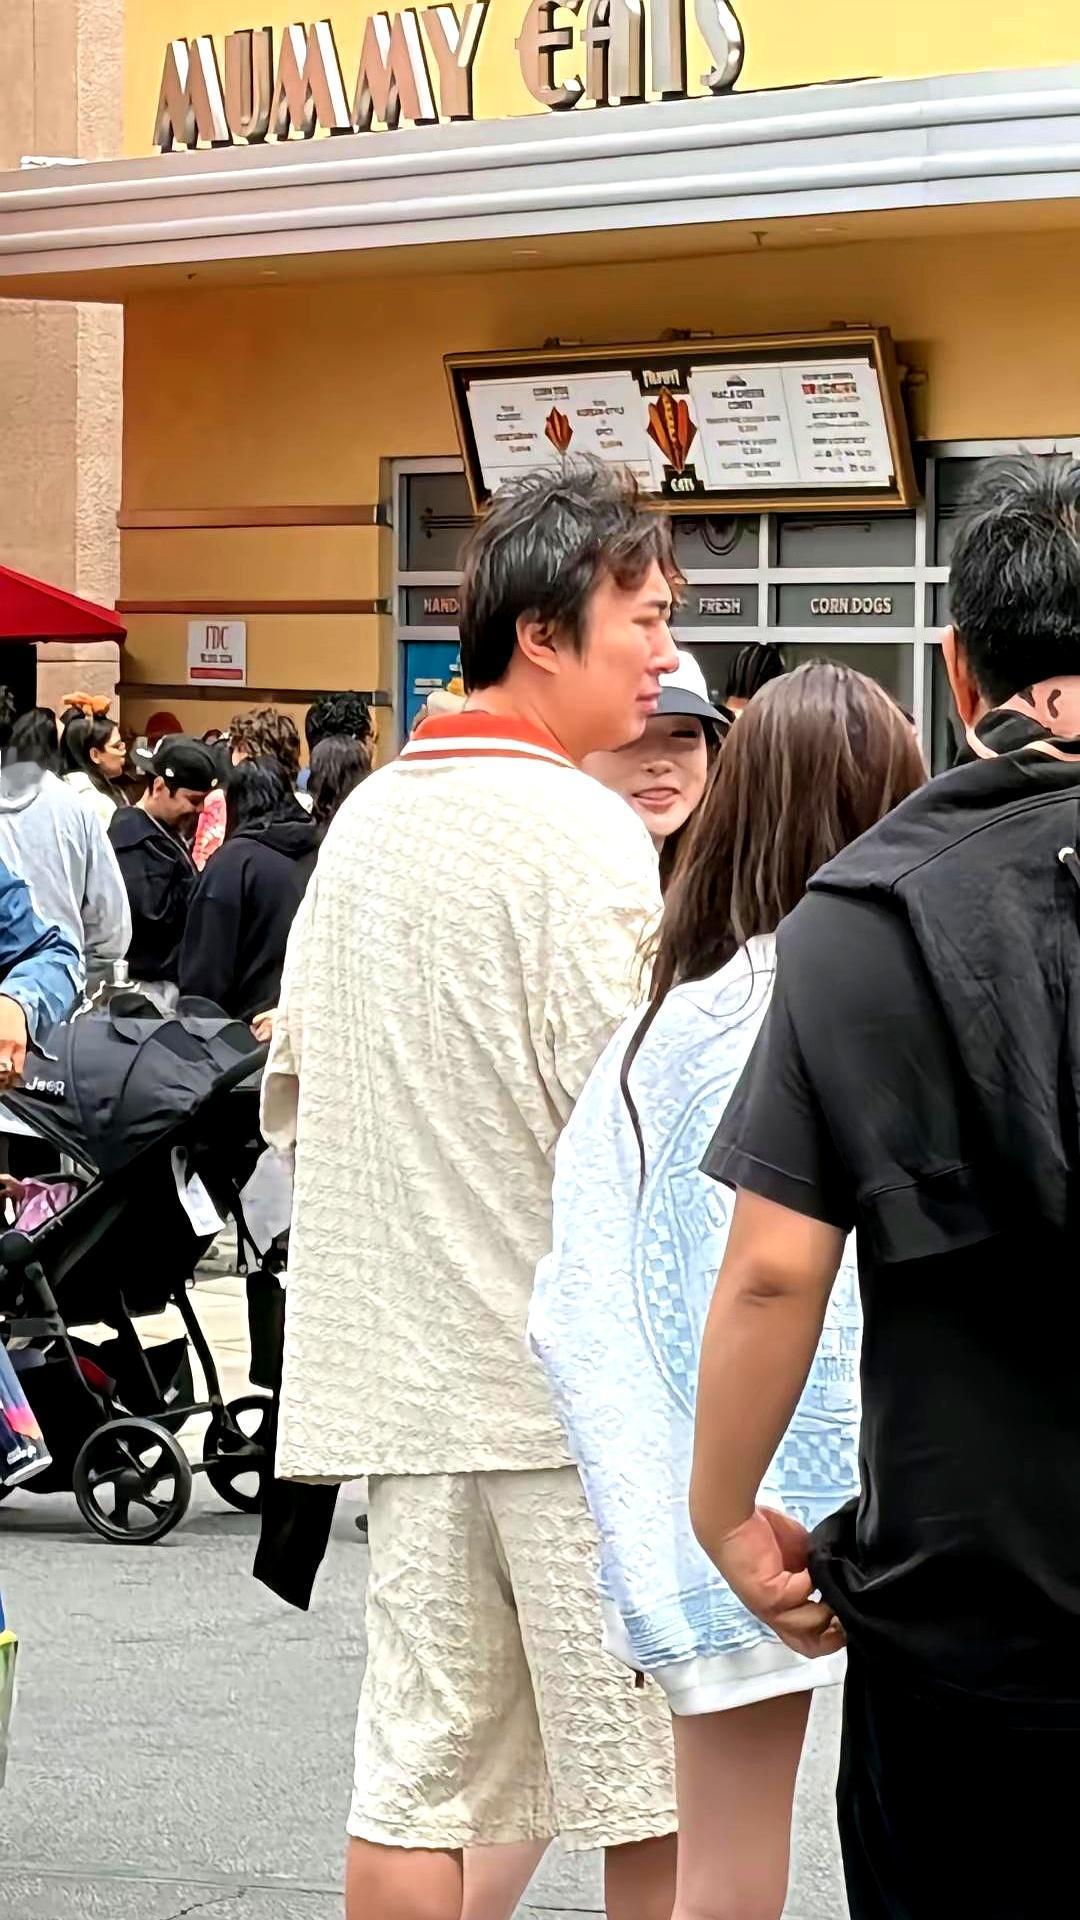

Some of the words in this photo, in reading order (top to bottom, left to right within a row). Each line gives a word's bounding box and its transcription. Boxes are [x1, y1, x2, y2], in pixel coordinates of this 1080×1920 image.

[152, 1, 489, 153] MUMMY
[514, 0, 744, 110] EATS
[699, 598, 741, 614] FRESH
[811, 598, 849, 614] CORN
[851, 597, 892, 614] DOGS
